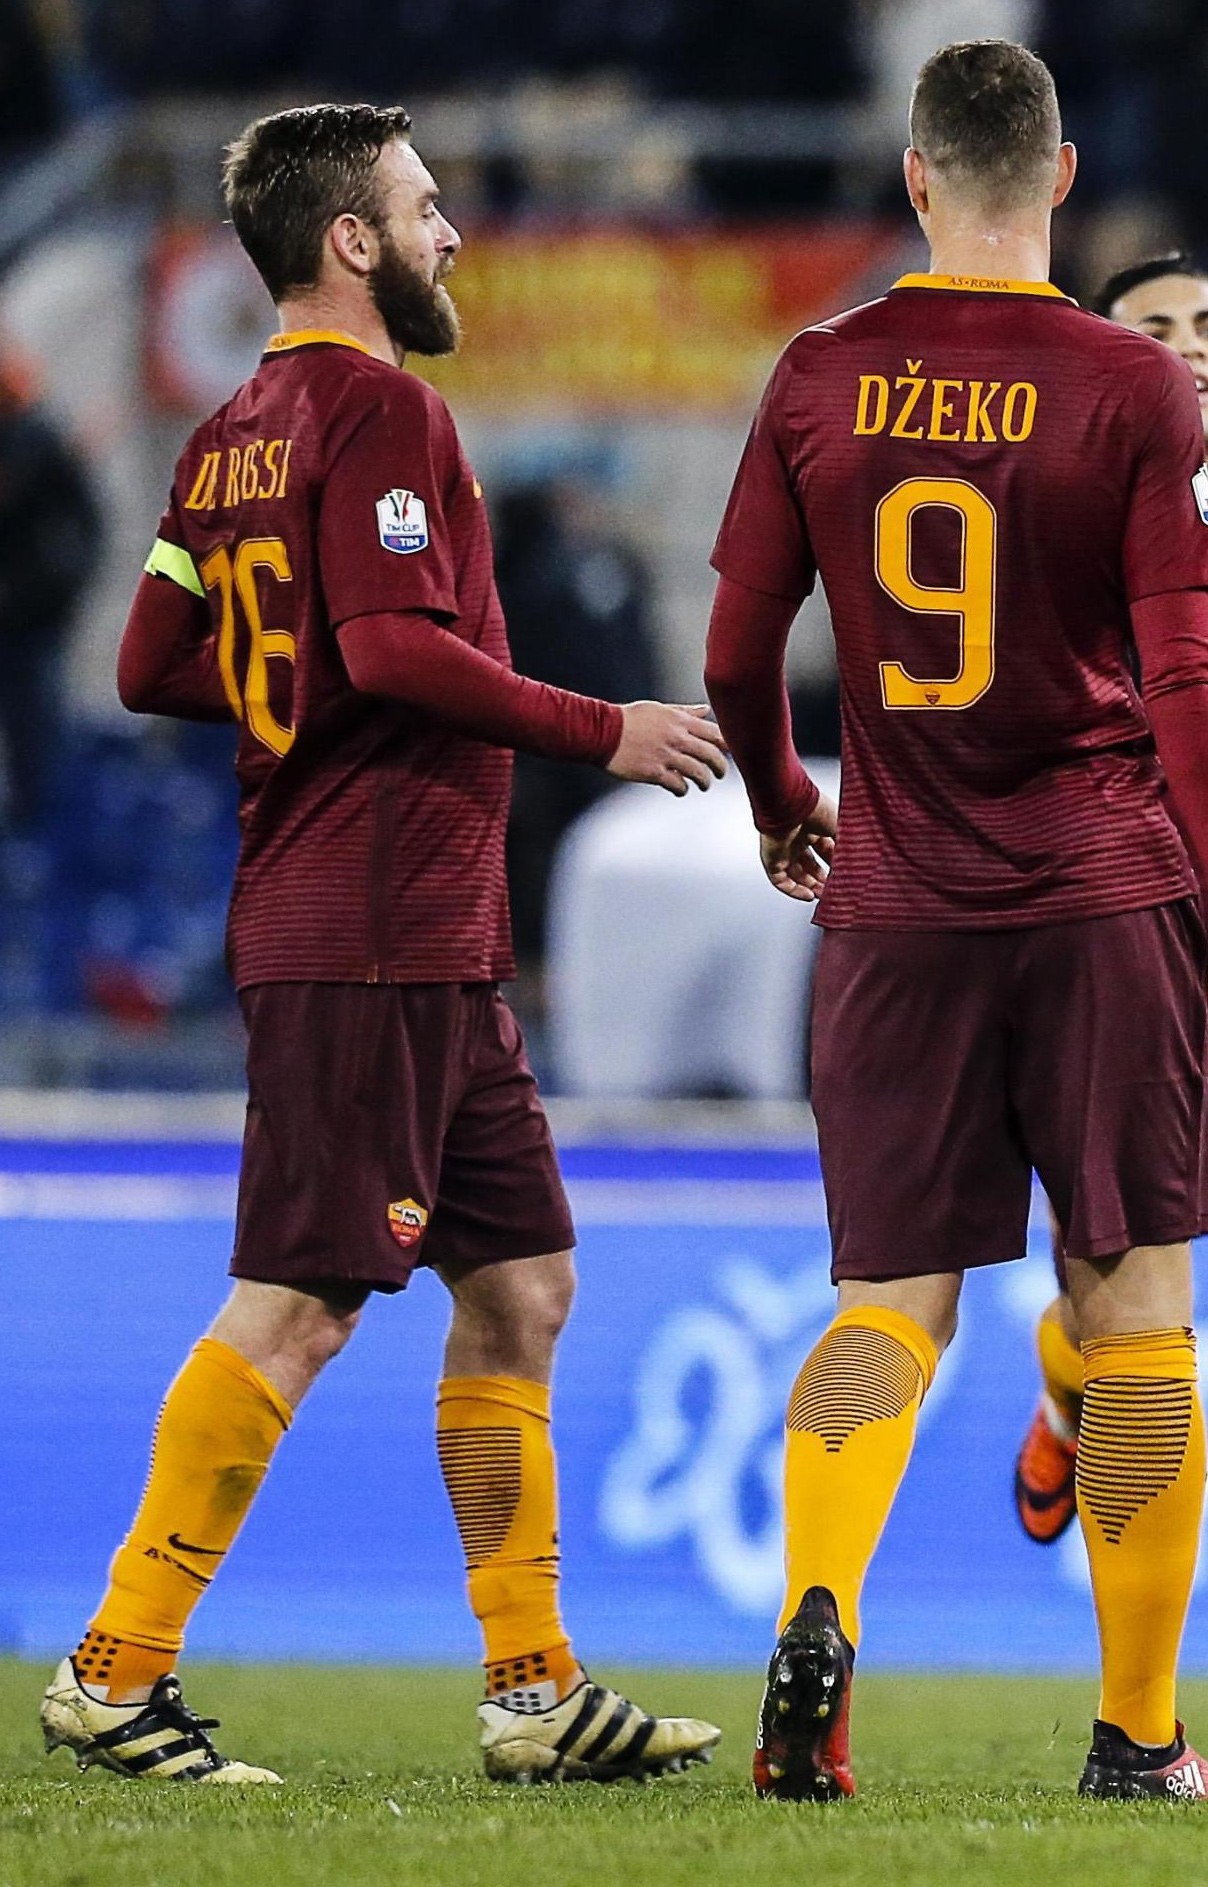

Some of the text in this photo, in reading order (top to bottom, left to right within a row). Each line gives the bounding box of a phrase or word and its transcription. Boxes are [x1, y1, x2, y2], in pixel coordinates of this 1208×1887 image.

[853, 358, 1038, 443] DŽEKO
[399, 537, 419, 547] TIM
[874, 476, 997, 710] 9
[201, 536, 297, 759] 16
